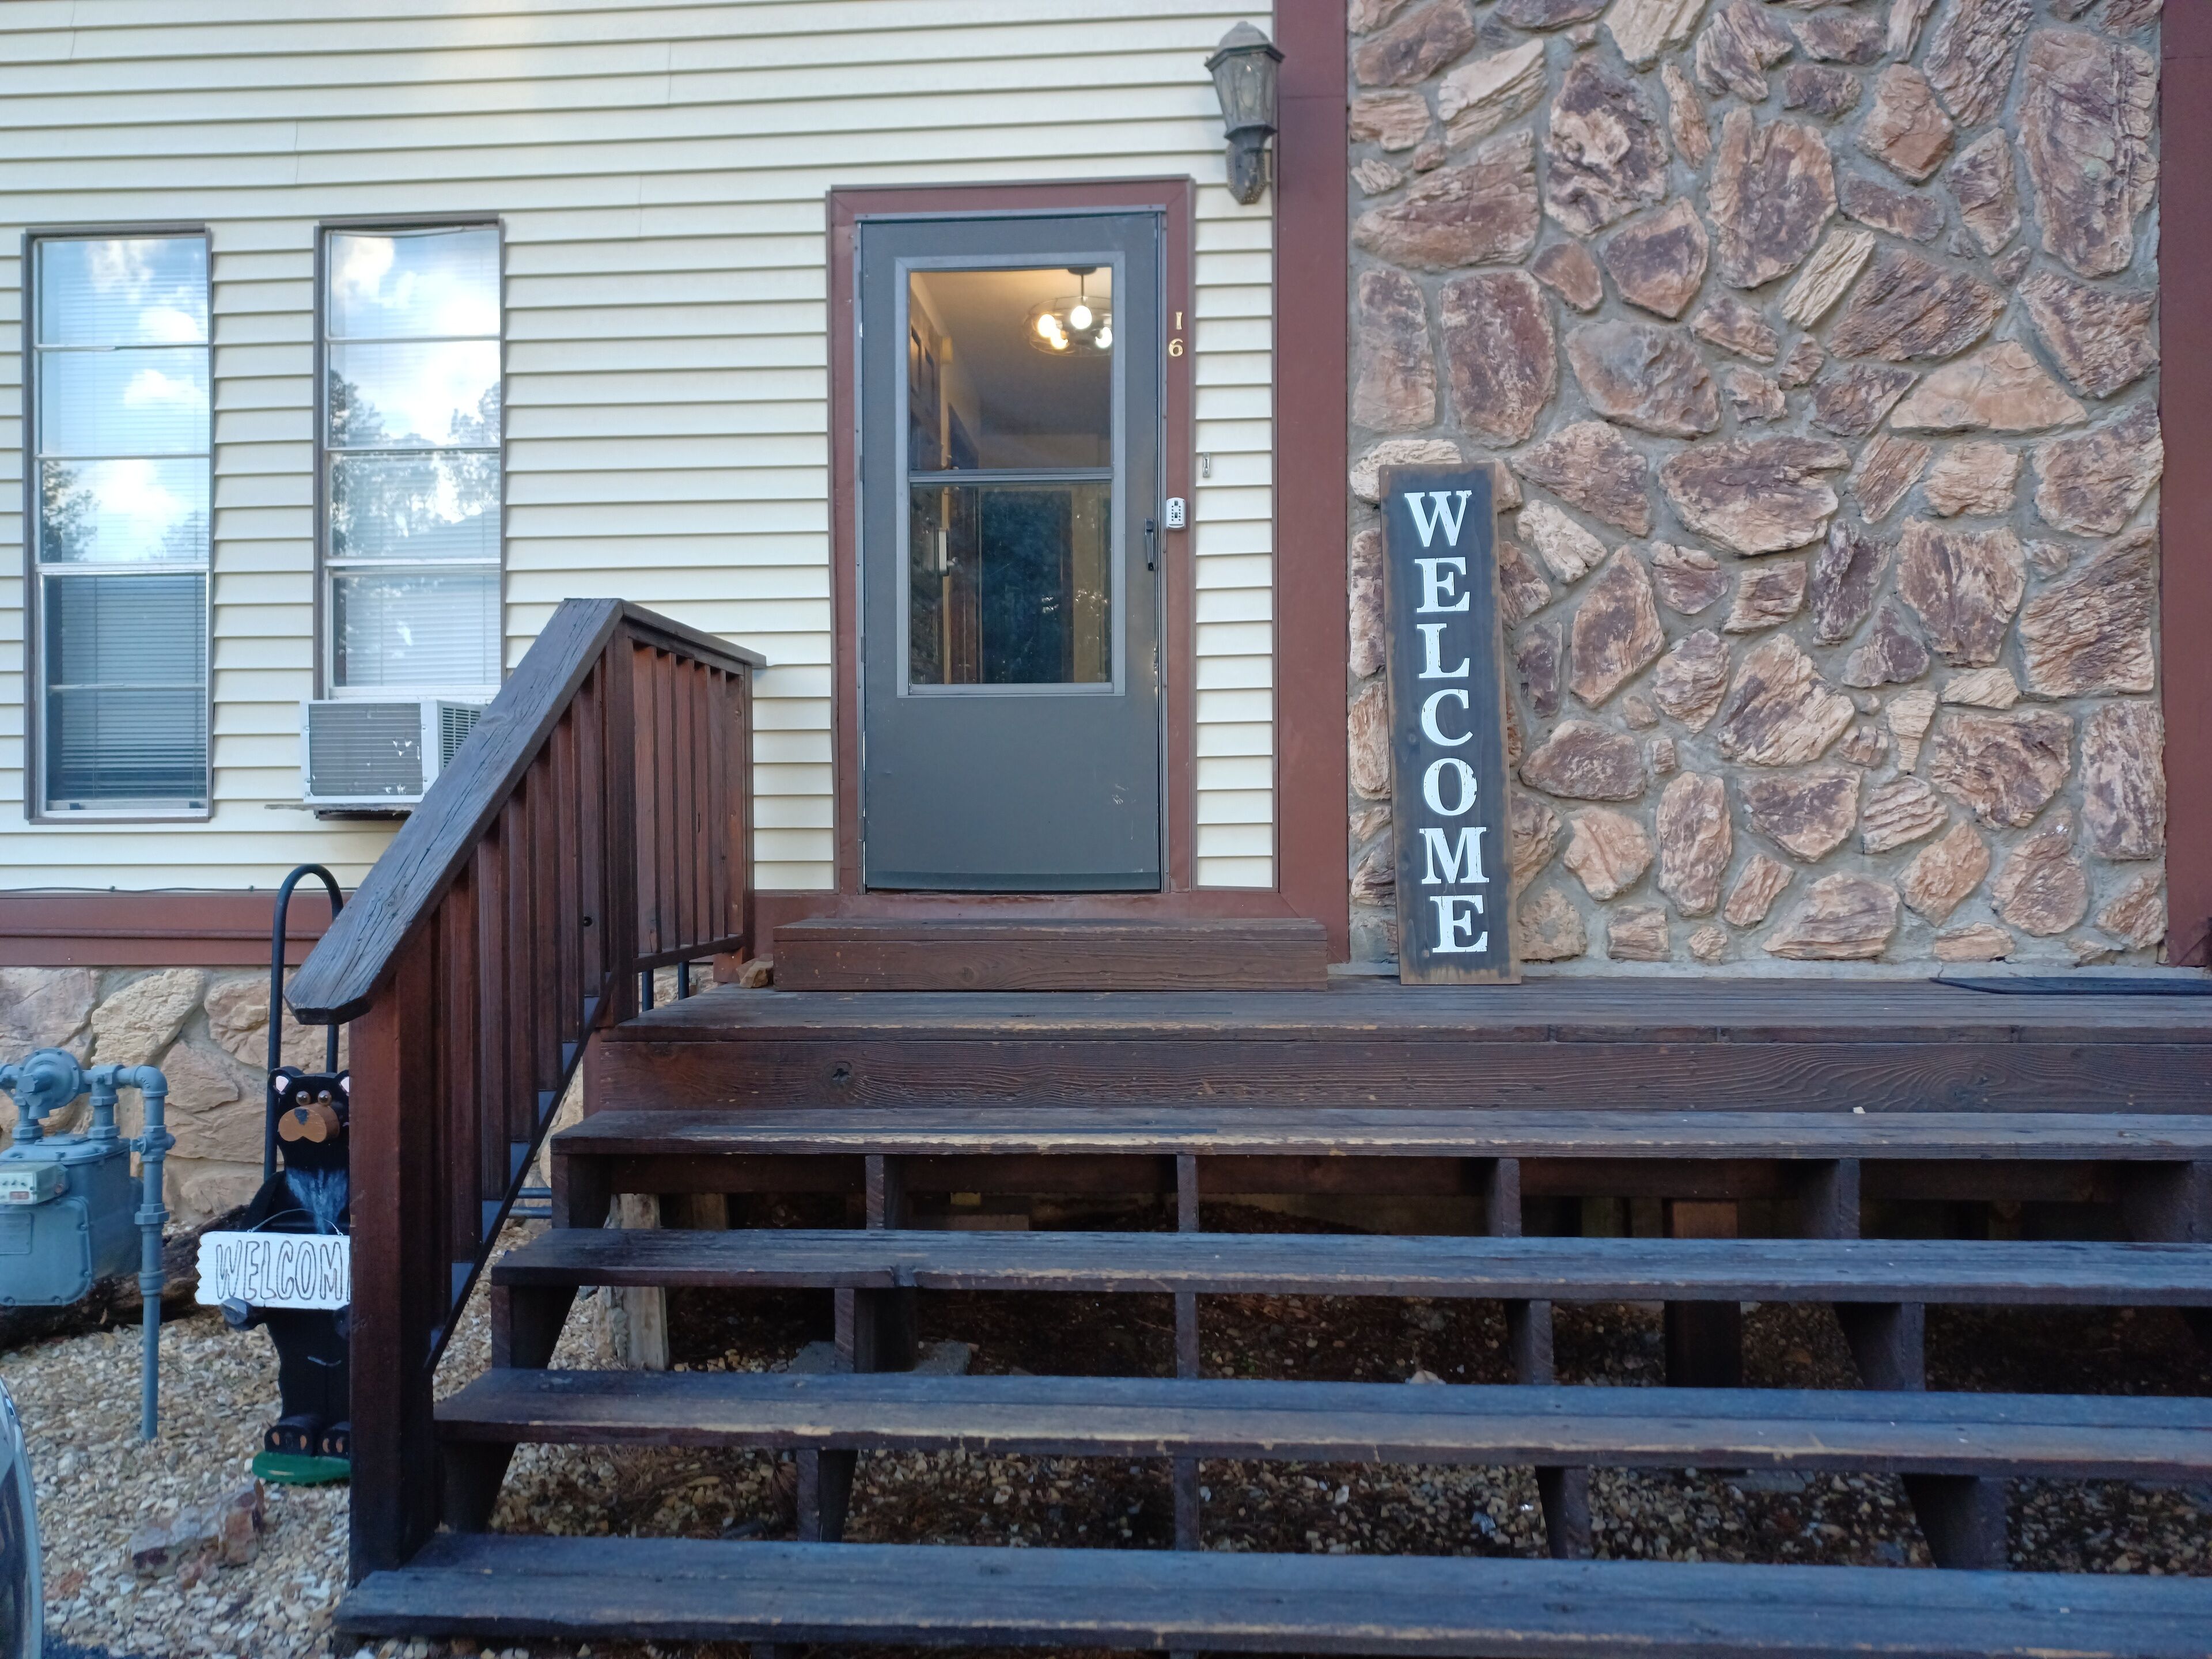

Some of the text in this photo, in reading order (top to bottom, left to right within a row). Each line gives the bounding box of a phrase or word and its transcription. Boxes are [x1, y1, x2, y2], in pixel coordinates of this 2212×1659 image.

[1168, 312, 1183, 357] 16
[1404, 490, 1489, 953] WELCOME
[215, 1240, 350, 1301] WELCOM
